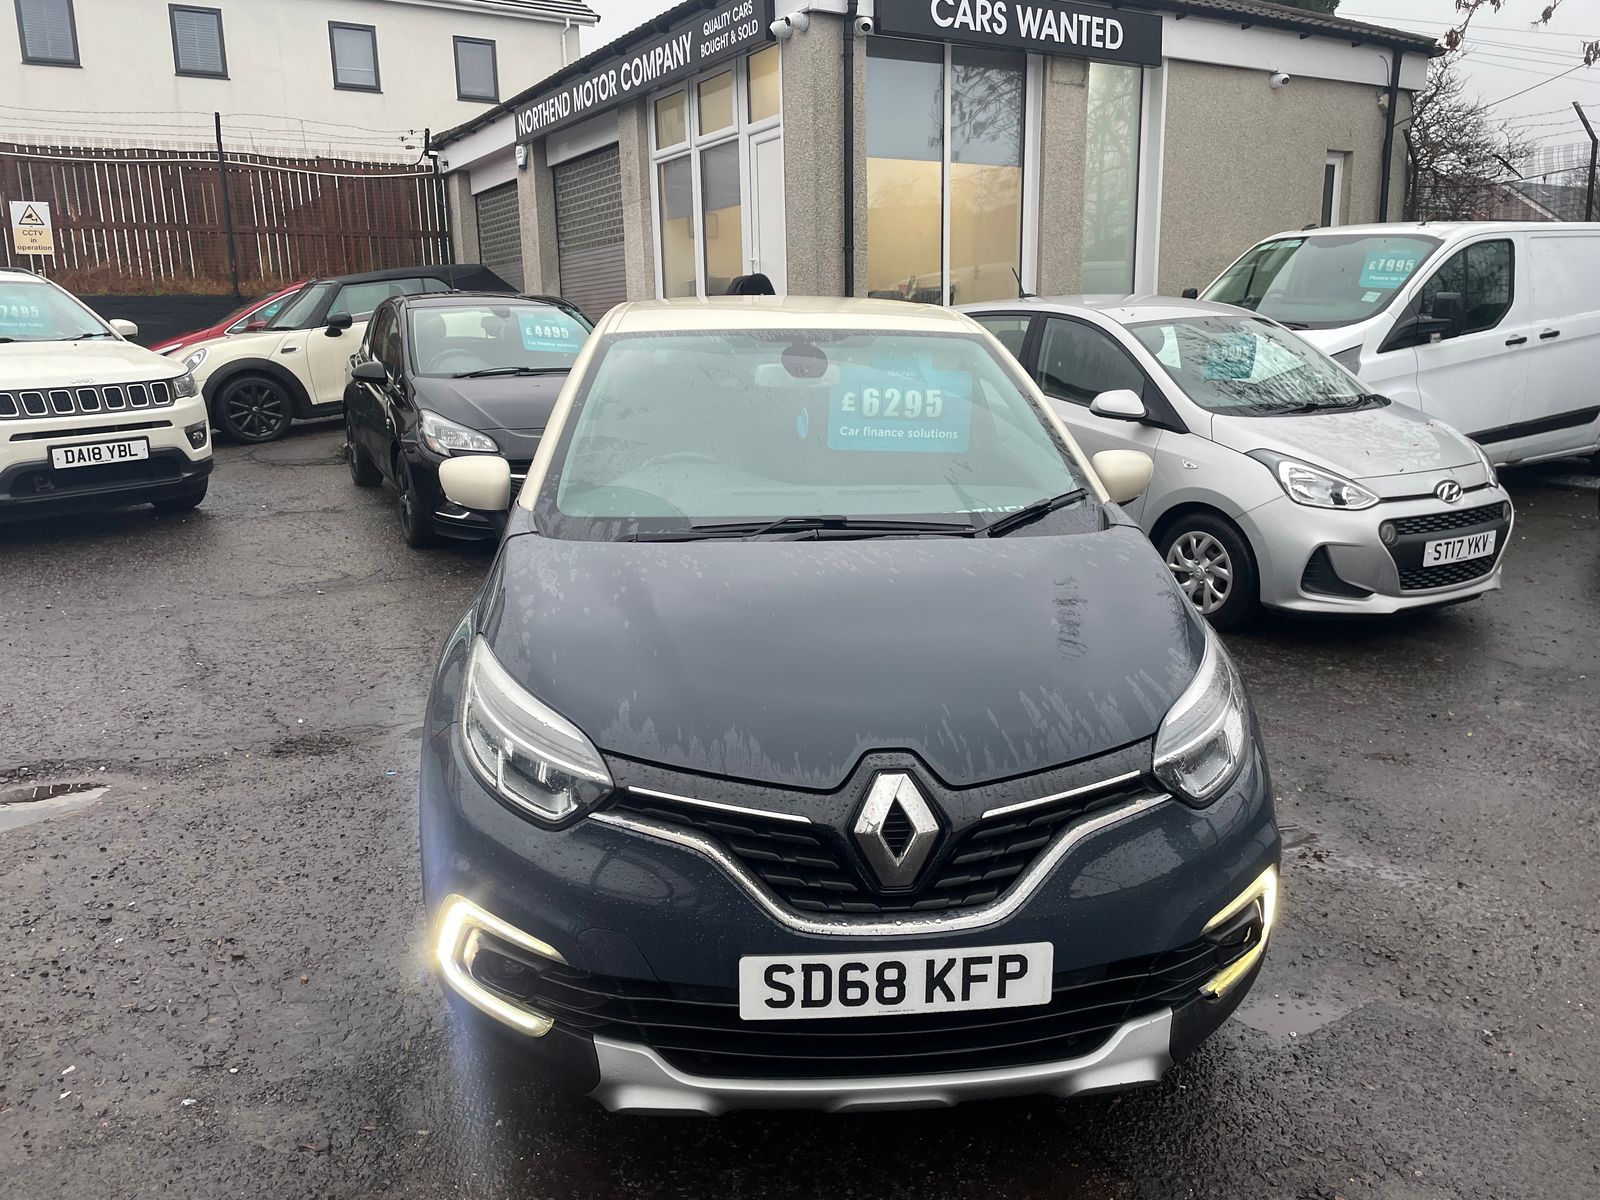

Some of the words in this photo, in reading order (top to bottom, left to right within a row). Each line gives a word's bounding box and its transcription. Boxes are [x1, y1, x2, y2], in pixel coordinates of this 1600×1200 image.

[703, 10, 731, 36] QUALITY
[732, 0, 753, 21] CARS
[930, 0, 1007, 35] CARS
[1016, 4, 1124, 50] WANTED
[700, 32, 729, 58] BOUGHT
[730, 30, 737, 44] &
[738, 19, 759, 41] SOLD
[518, 91, 570, 136] NORTHEND
[573, 69, 618, 112] MOTOR
[620, 31, 692, 91] COMPANY
[1368, 258, 1416, 272] £7995
[840, 426, 860, 437] Car
[863, 426, 904, 438] finance
[907, 428, 959, 439] solutions
[64, 446, 103, 464] DA18
[106, 443, 138, 459] YBL
[1433, 539, 1464, 561] ST17
[1467, 534, 1489, 555] YKV
[764, 961, 907, 1008] SD68
[925, 954, 1028, 1003] KFP
